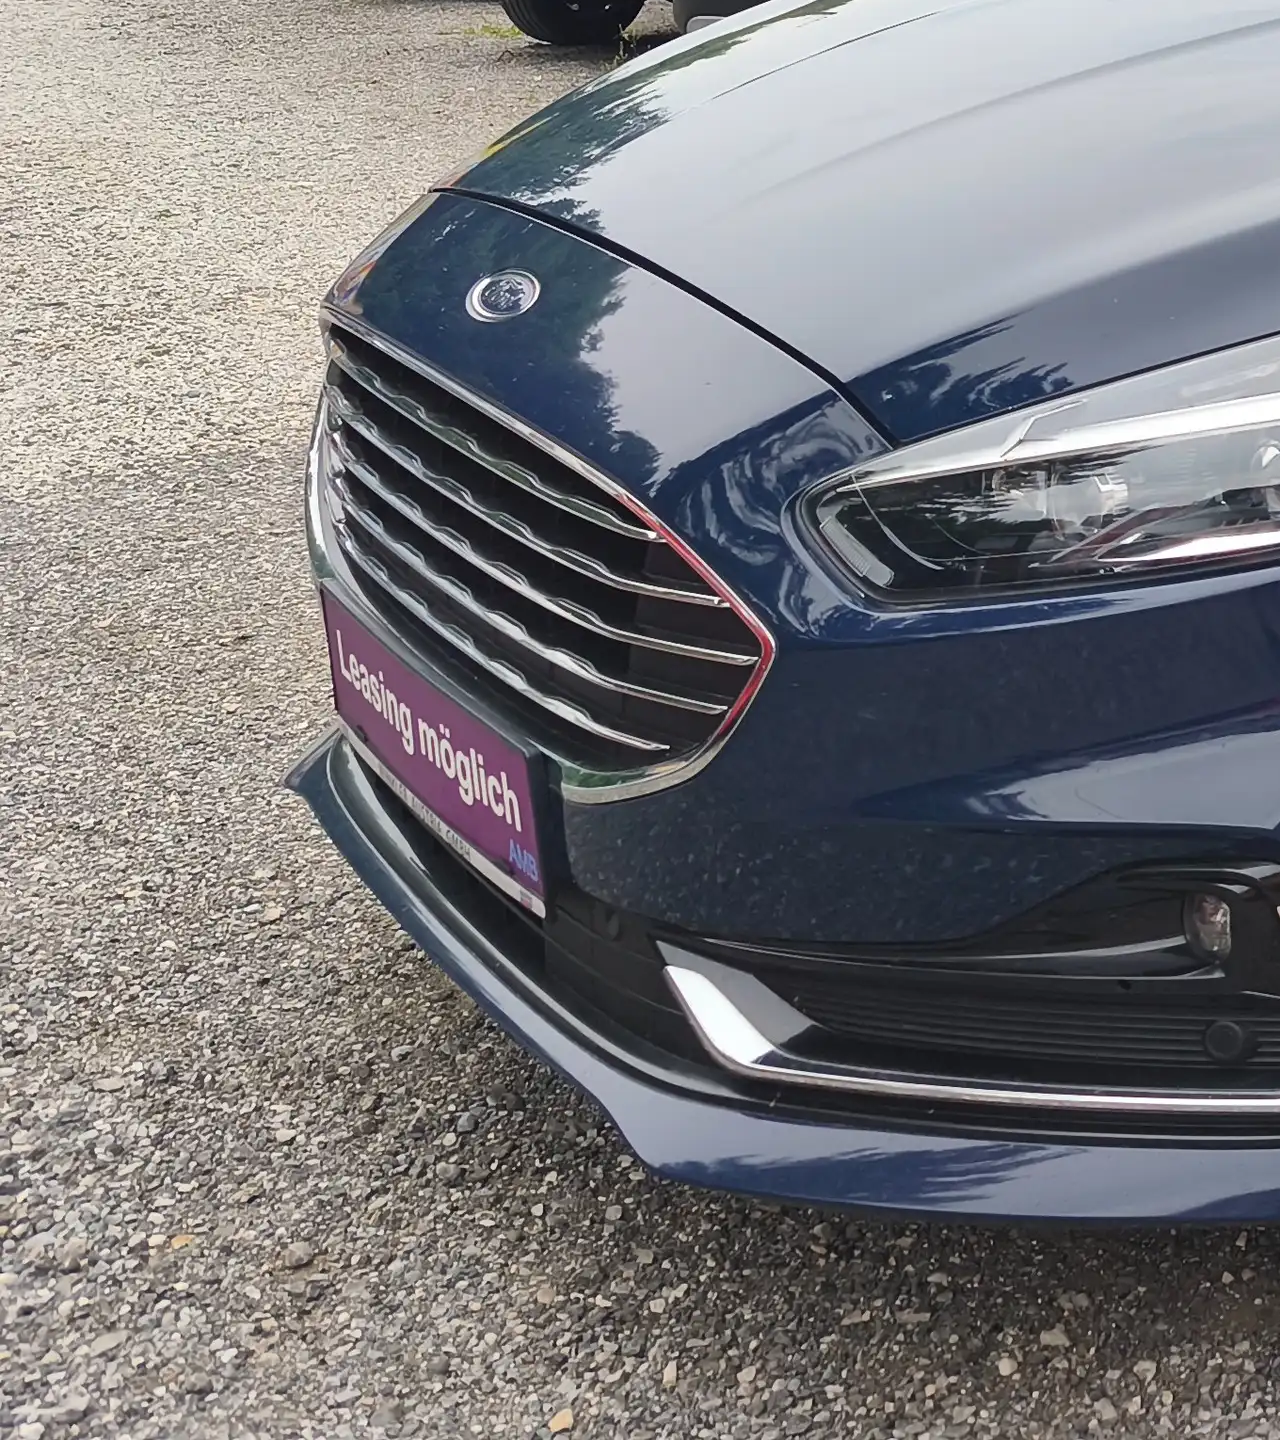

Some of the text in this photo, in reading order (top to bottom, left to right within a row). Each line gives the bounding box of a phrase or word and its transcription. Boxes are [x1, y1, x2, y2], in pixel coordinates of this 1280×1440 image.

[336, 629, 522, 832] Leasing möglich
[508, 838, 539, 882] AMB
